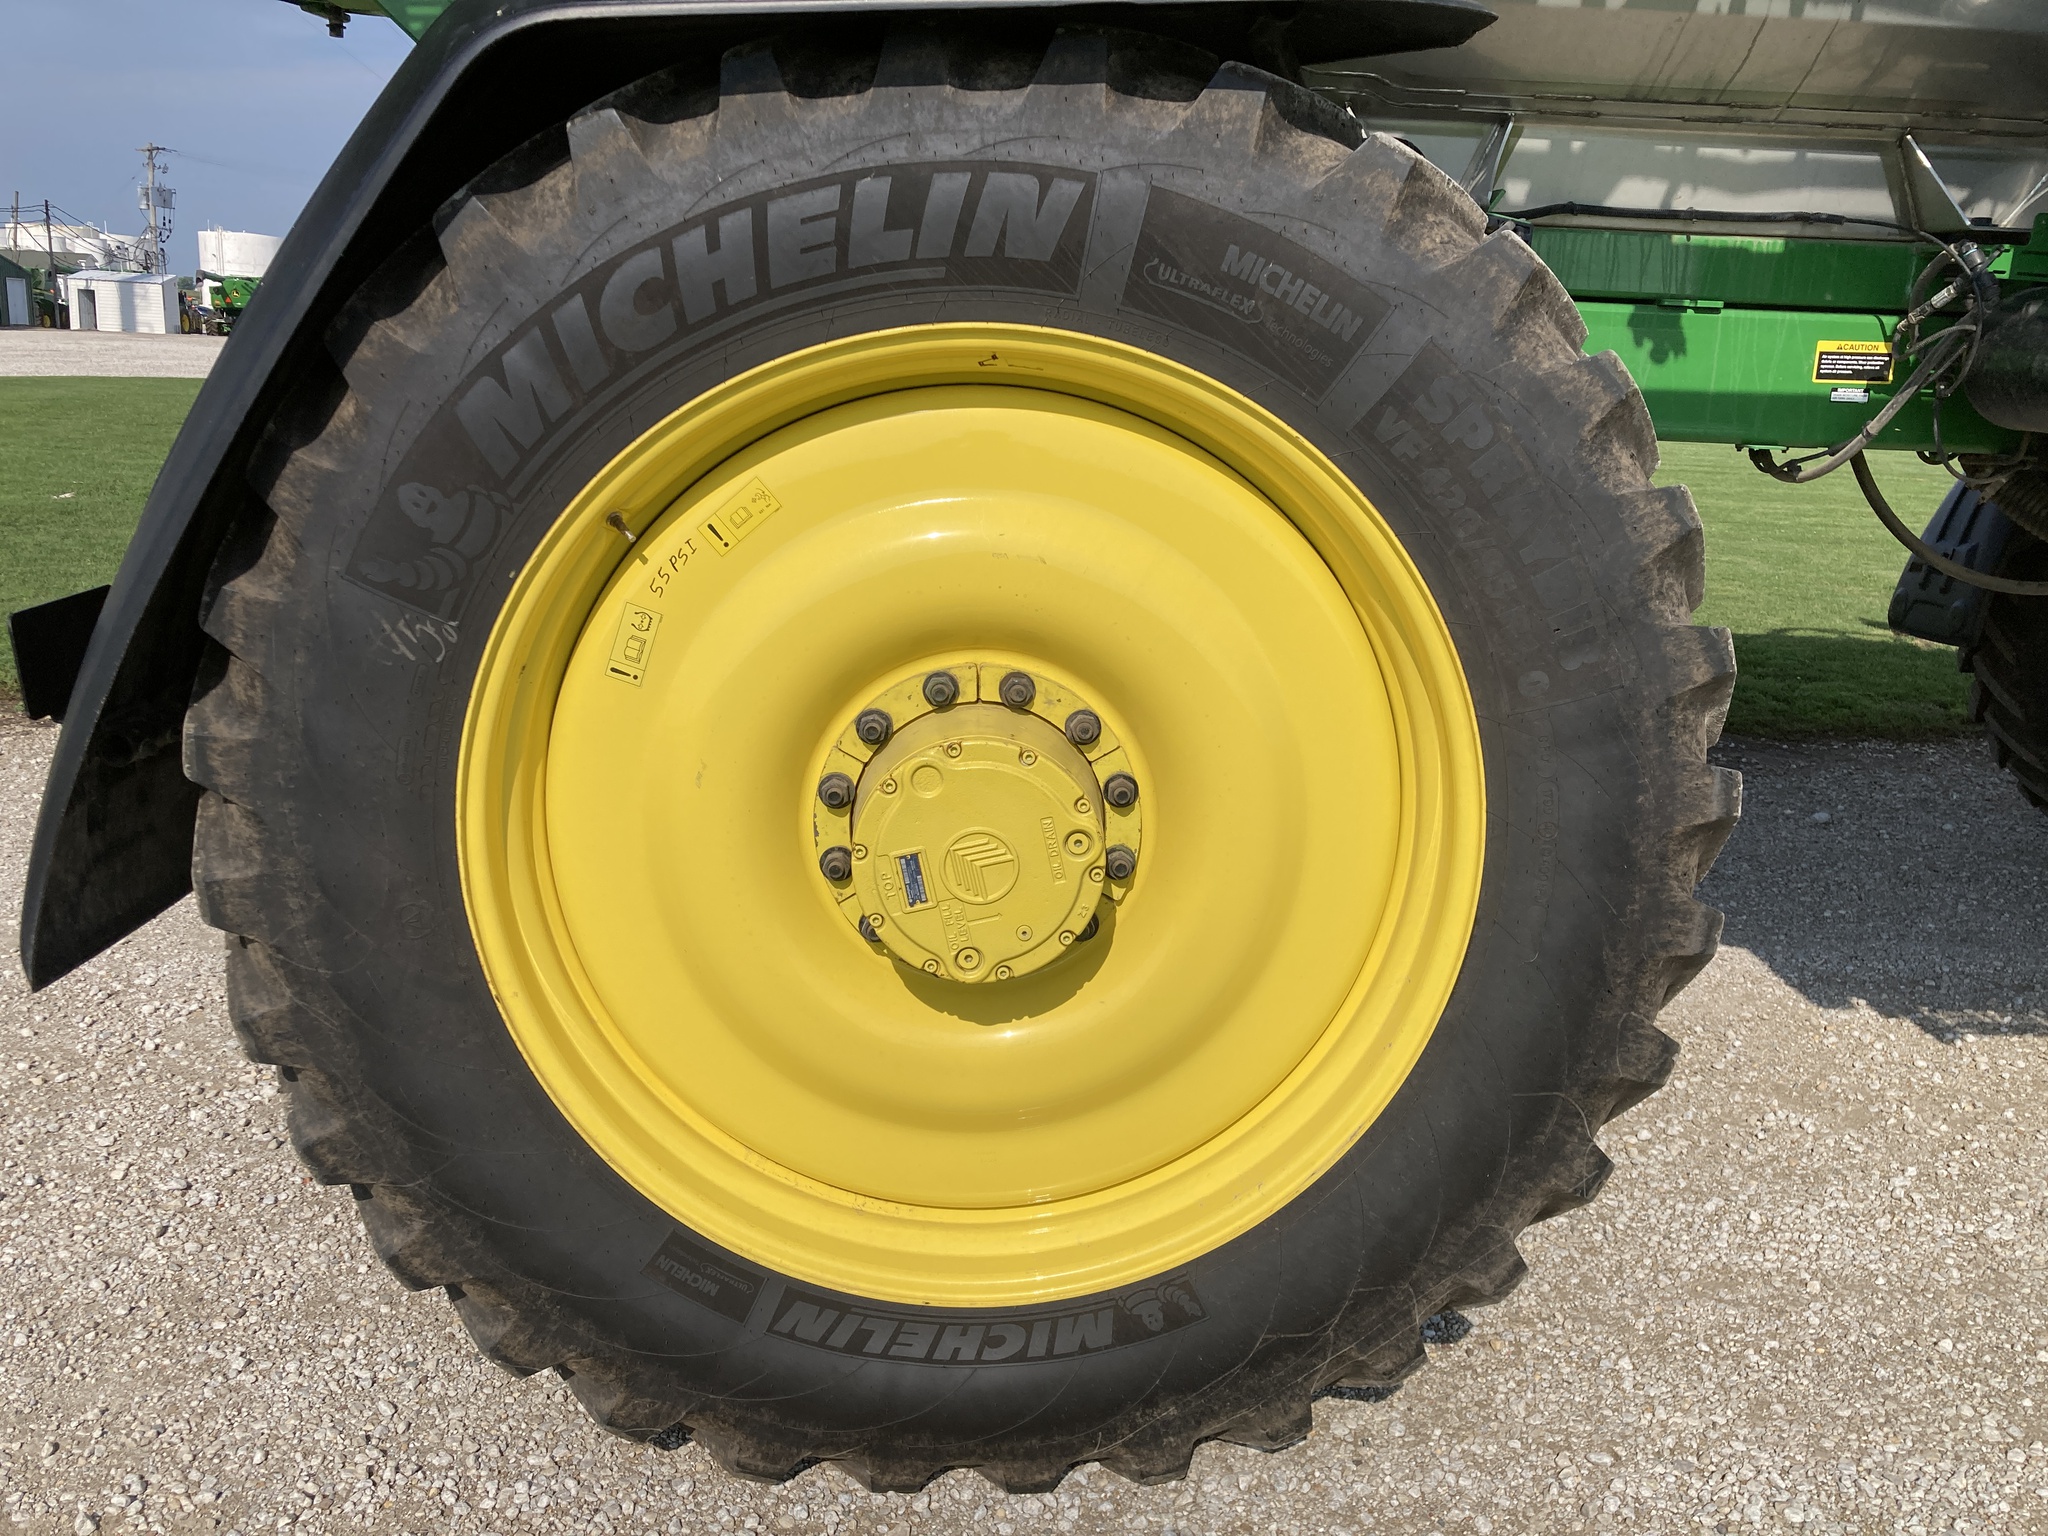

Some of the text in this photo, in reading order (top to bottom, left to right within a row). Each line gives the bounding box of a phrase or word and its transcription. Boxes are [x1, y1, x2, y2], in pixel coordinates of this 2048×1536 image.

[1158, 264, 1257, 315] ULTRAFLEX
[1219, 243, 1364, 343] MICHELIN
[453, 170, 1088, 480] MICHELIN
[1263, 318, 1335, 370] Technologies
[1843, 343, 1880, 352] CAUTION
[668, 537, 698, 573] PSI
[1042, 820, 1064, 880] OIL DRAIN
[881, 871, 897, 901] TOP
[941, 903, 960, 951] OIL FILL
[954, 906, 970, 943] LEVEL
[655, 1253, 720, 1298] MICHELIN
[777, 1302, 1116, 1363] MICHELIN
